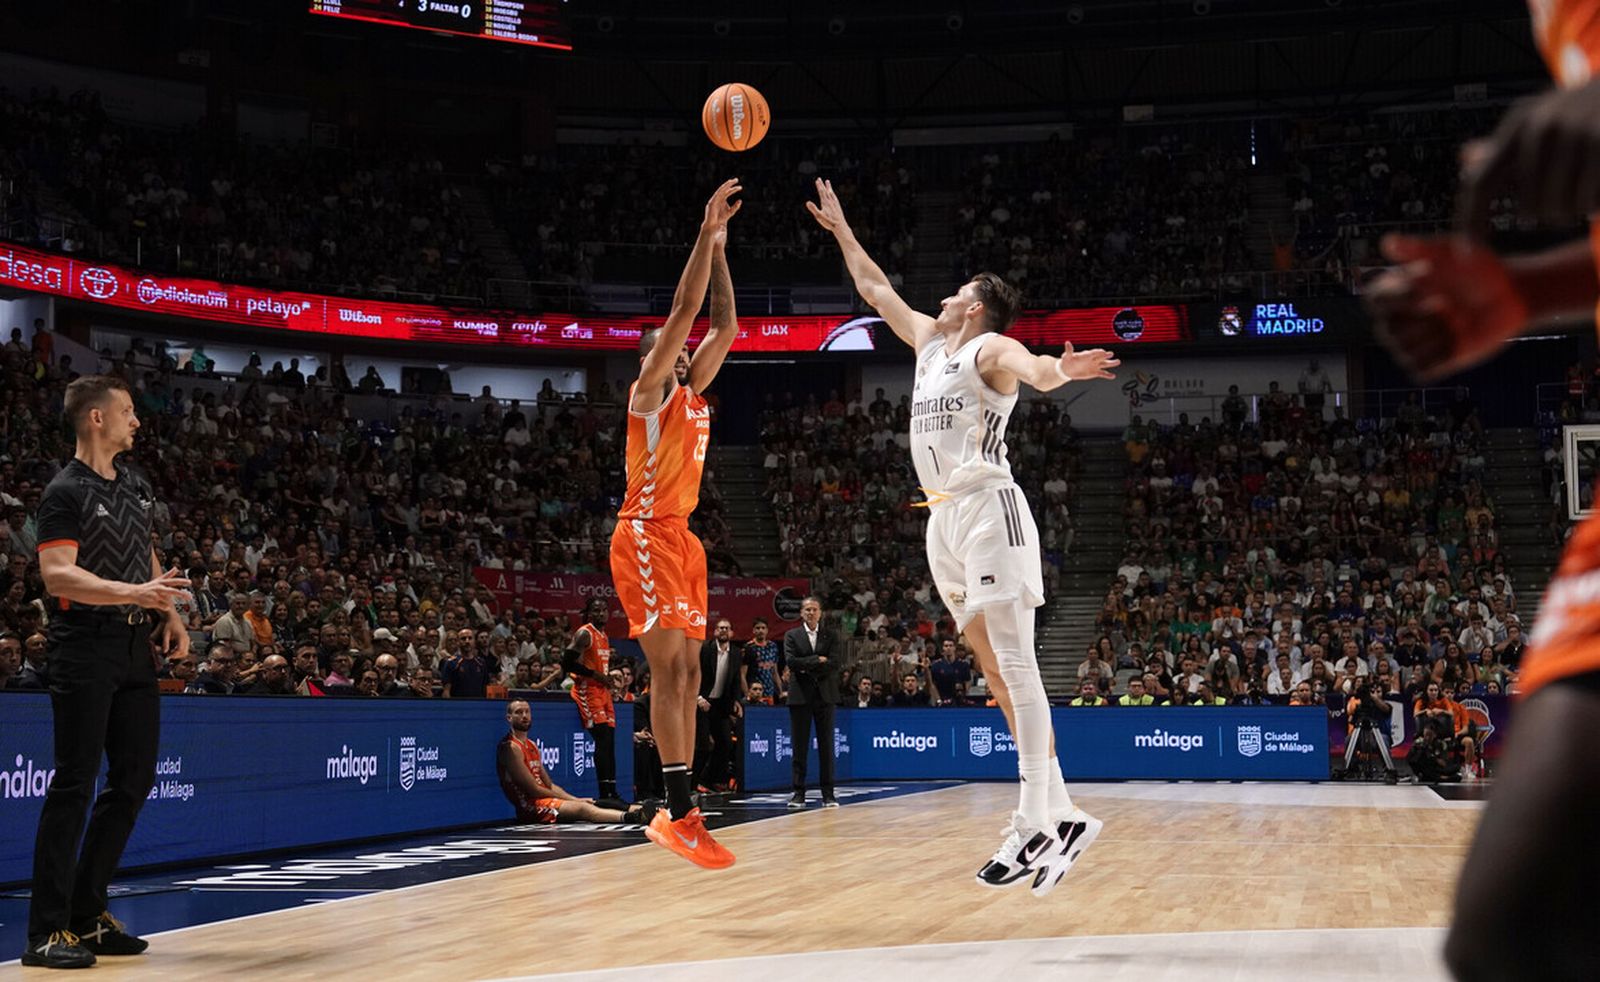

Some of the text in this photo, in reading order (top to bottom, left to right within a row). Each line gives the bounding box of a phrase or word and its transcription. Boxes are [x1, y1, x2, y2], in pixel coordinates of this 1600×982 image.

[418, 0, 471, 18] 3 FALTAS 0
[731, 94, 745, 140] Wilson
[140, 283, 228, 308] mediolanum
[247, 297, 301, 319] pelayo
[1256, 303, 1298, 318] REAL
[339, 309, 382, 325] Wilson
[454, 321, 499, 331] KUMHO
[512, 320, 547, 334] renfe
[761, 324, 789, 336] UAX
[1256, 319, 1325, 335] MADRID
[928, 445, 940, 476] 1
[735, 586, 767, 598] pelayo
[1264, 731, 1299, 742] Ciudad
[417, 746, 439, 761] Ciudad
[994, 742, 1007, 752] de
[1265, 741, 1314, 754] de Málaga
[416, 765, 447, 782] de Málaga
[160, 780, 195, 802] Málaga
